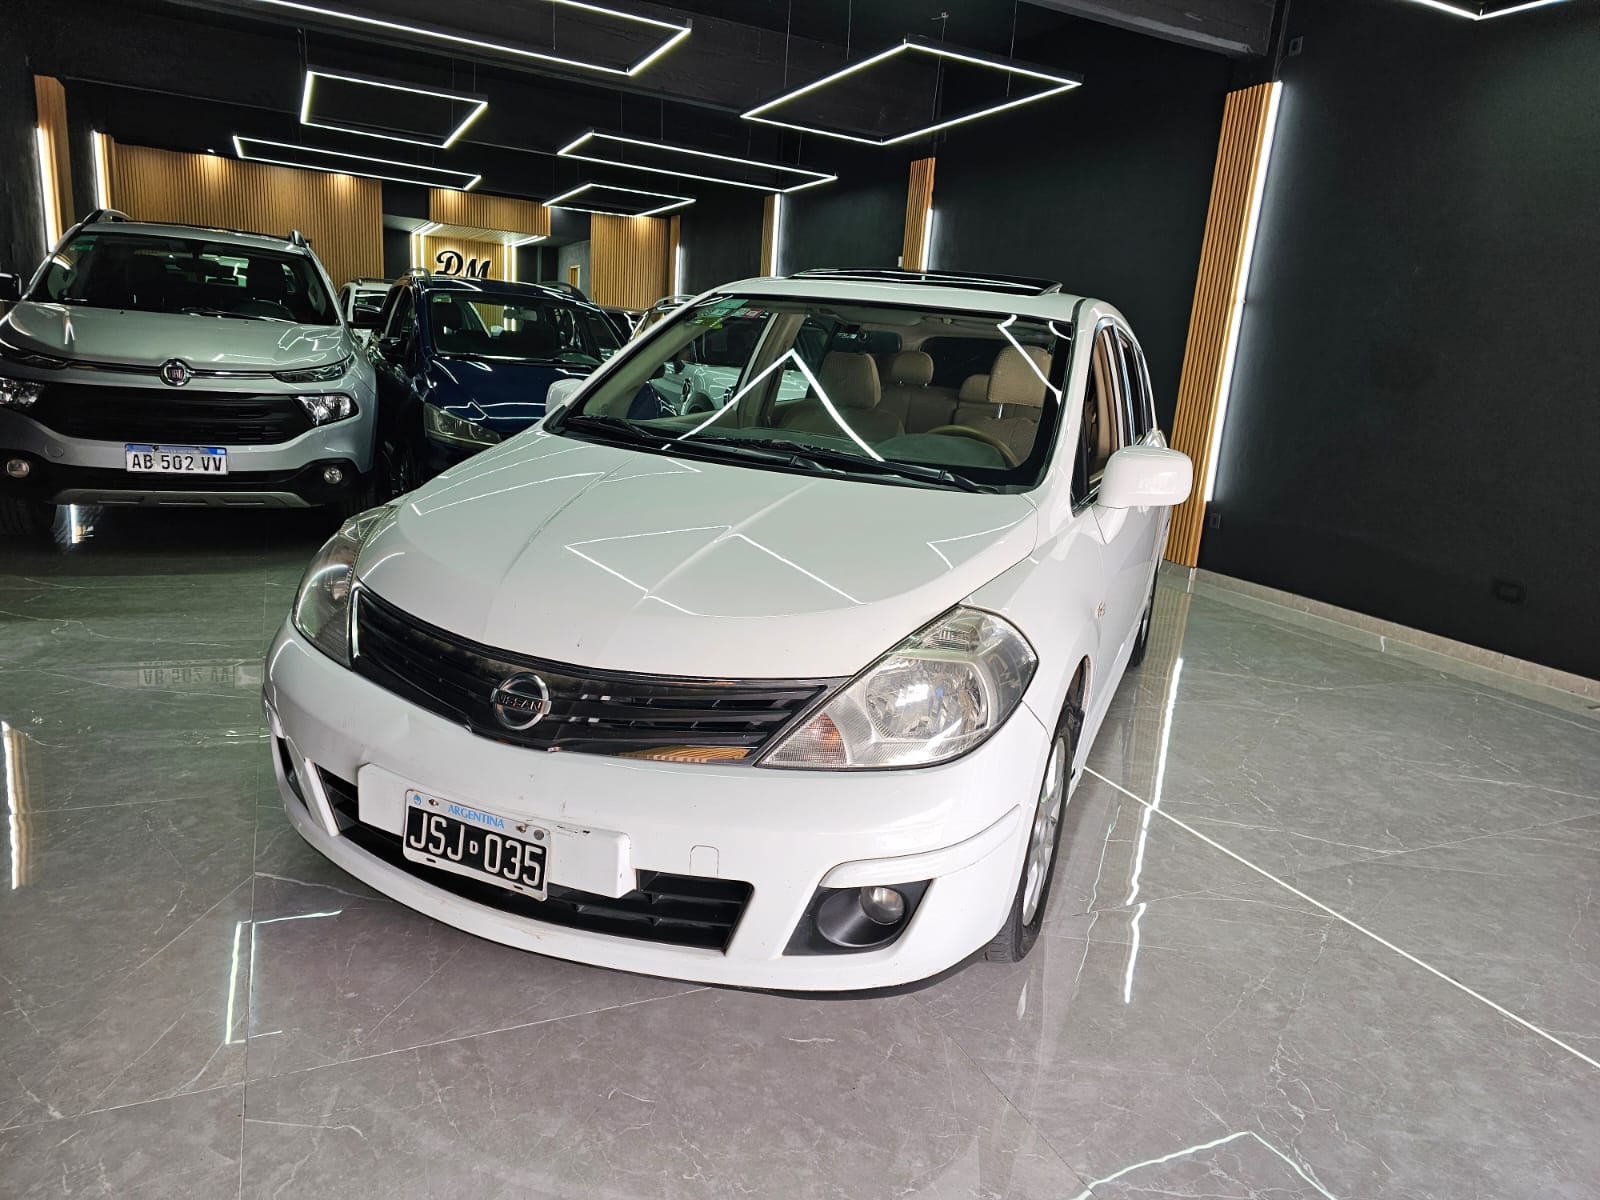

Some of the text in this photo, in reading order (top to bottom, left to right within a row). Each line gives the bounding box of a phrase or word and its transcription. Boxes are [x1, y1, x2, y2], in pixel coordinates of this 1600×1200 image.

[435, 250, 491, 278] DM
[132, 454, 222, 472] AB 502 VV
[448, 804, 505, 829] ARGENTINA
[409, 812, 466, 862] JSJ
[484, 833, 543, 887] 035
